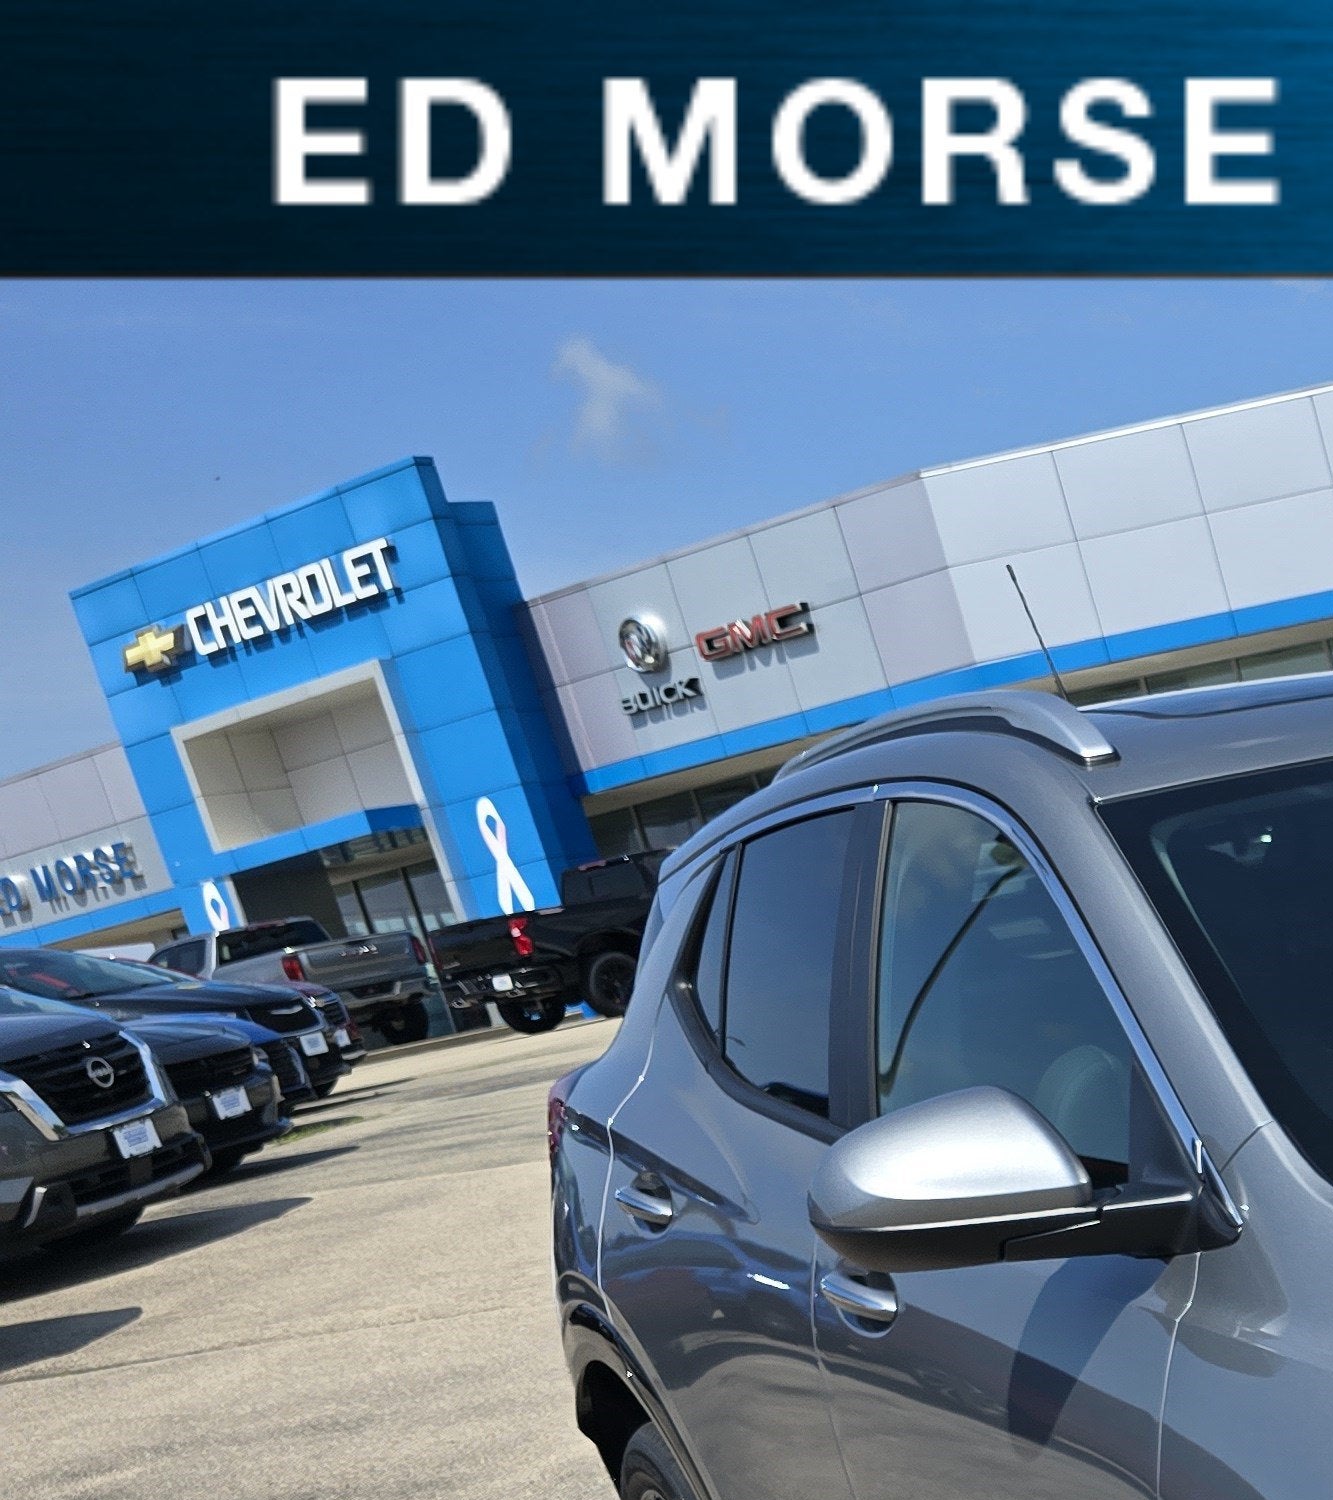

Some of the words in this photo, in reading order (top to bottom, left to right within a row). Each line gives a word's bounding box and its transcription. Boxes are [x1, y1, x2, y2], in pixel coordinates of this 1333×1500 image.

[186, 537, 394, 655] CHEVROLET
[695, 602, 815, 662] GMC
[621, 676, 704, 715] BUICK
[30, 842, 137, 902] MORSE
